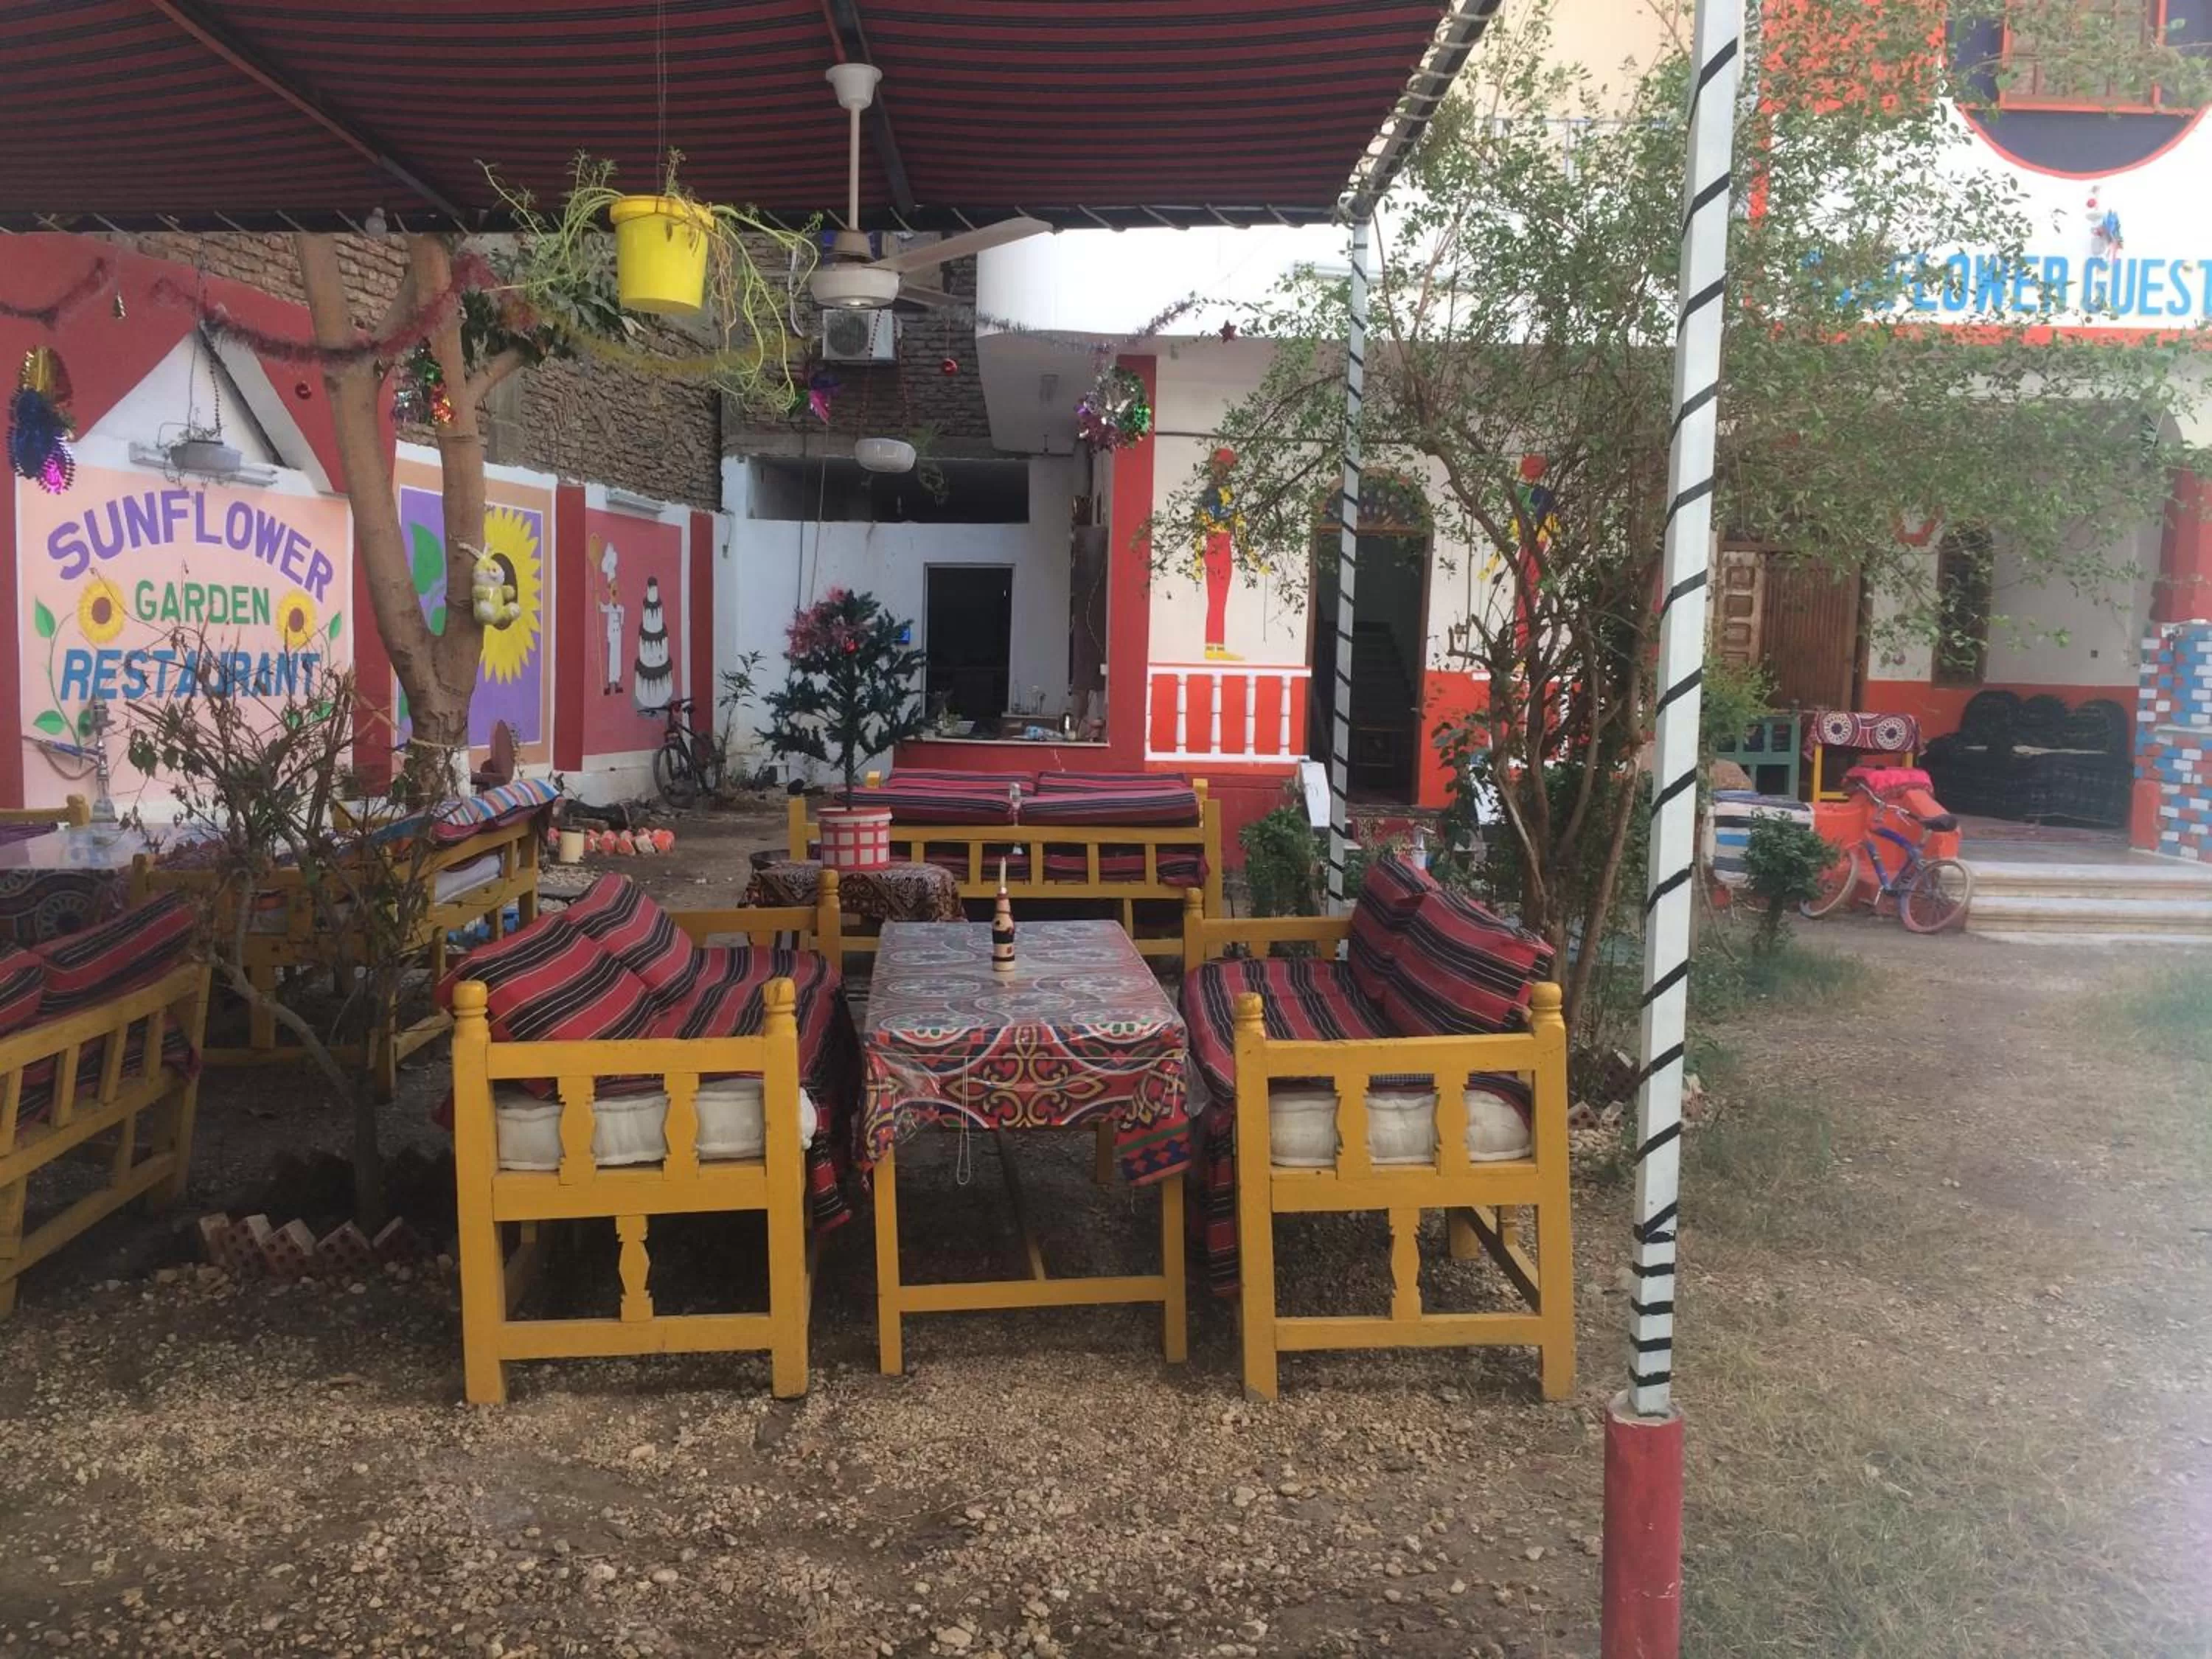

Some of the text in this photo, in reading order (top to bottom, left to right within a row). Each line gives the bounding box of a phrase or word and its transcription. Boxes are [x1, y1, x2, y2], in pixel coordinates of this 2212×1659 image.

[2081, 257, 2212, 316] GUEST
[47, 490, 334, 602] SUNFLOWER
[135, 580, 271, 626] GARDEN
[60, 649, 321, 701] RESTAURANT
